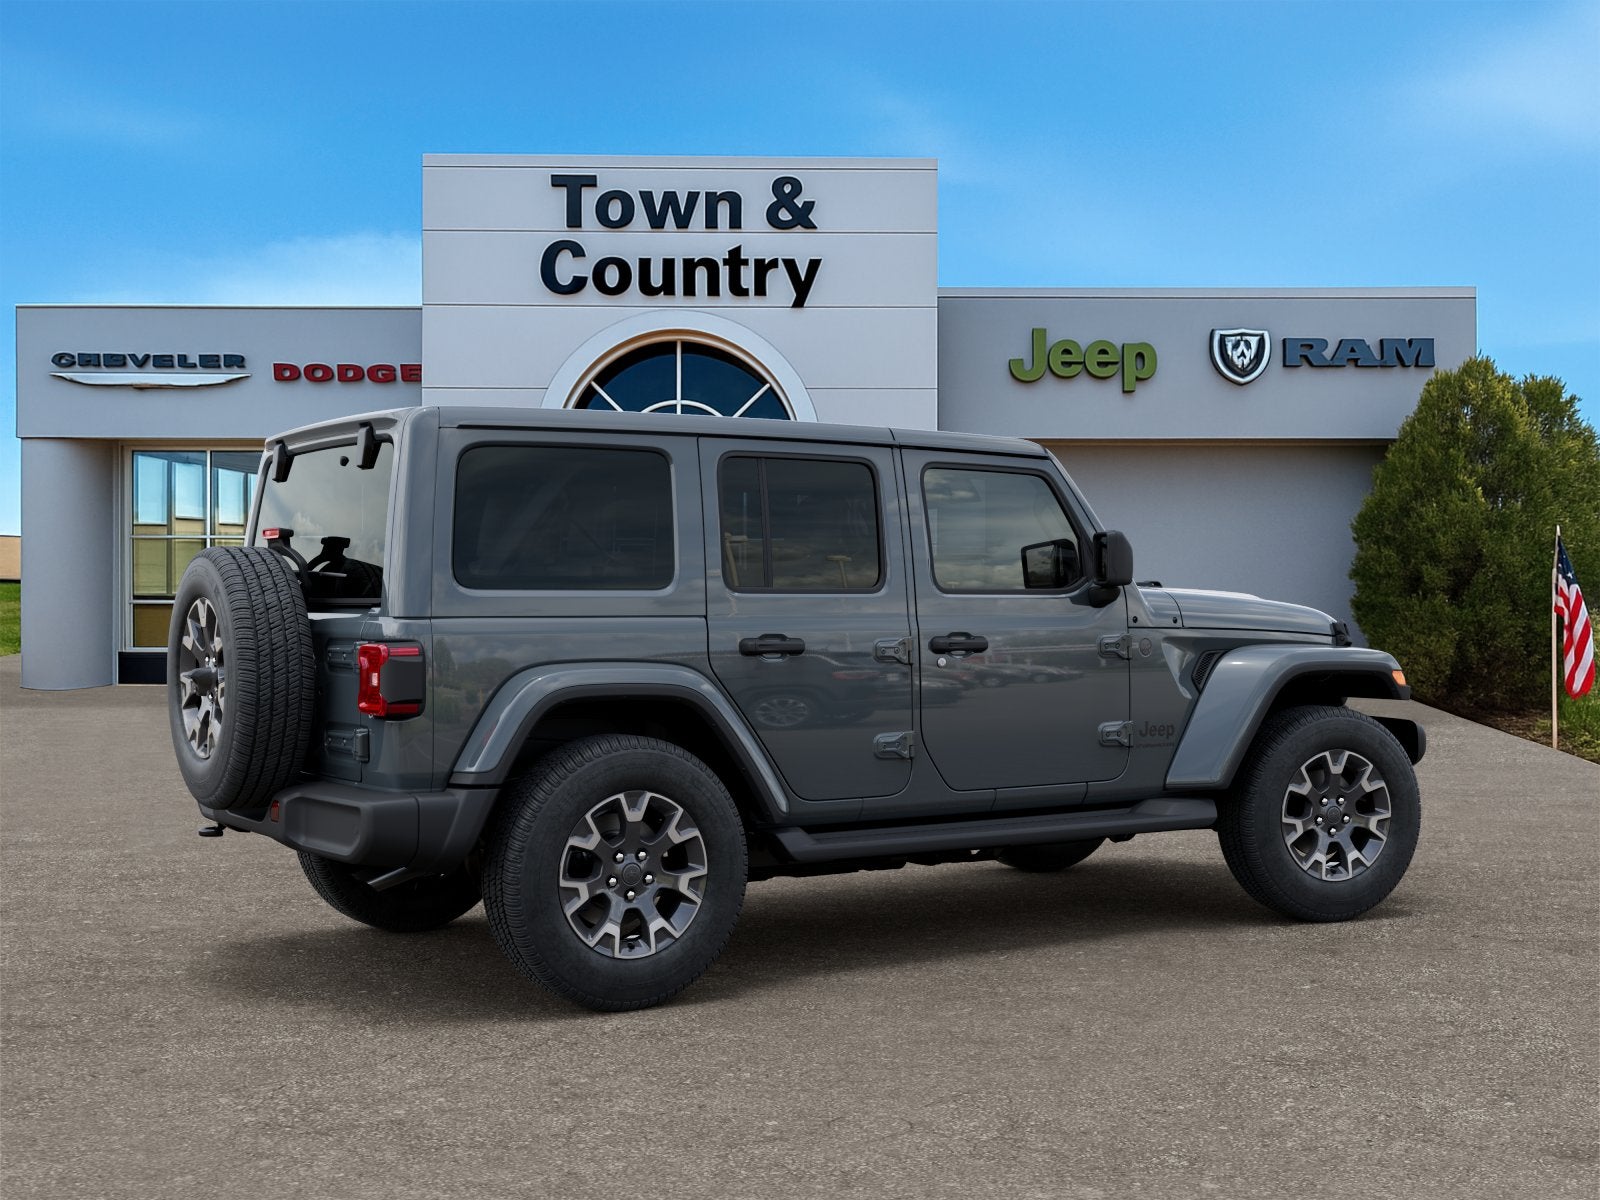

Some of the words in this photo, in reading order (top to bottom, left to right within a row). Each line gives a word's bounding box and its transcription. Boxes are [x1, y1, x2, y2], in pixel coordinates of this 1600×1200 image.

[551, 174, 743, 230] Town
[765, 175, 818, 230] &
[541, 239, 822, 308] Country
[273, 363, 422, 383] DODGE
[1009, 328, 1157, 393] Jeep
[1283, 338, 1435, 367] RAM
[1139, 721, 1175, 739] Jeep
